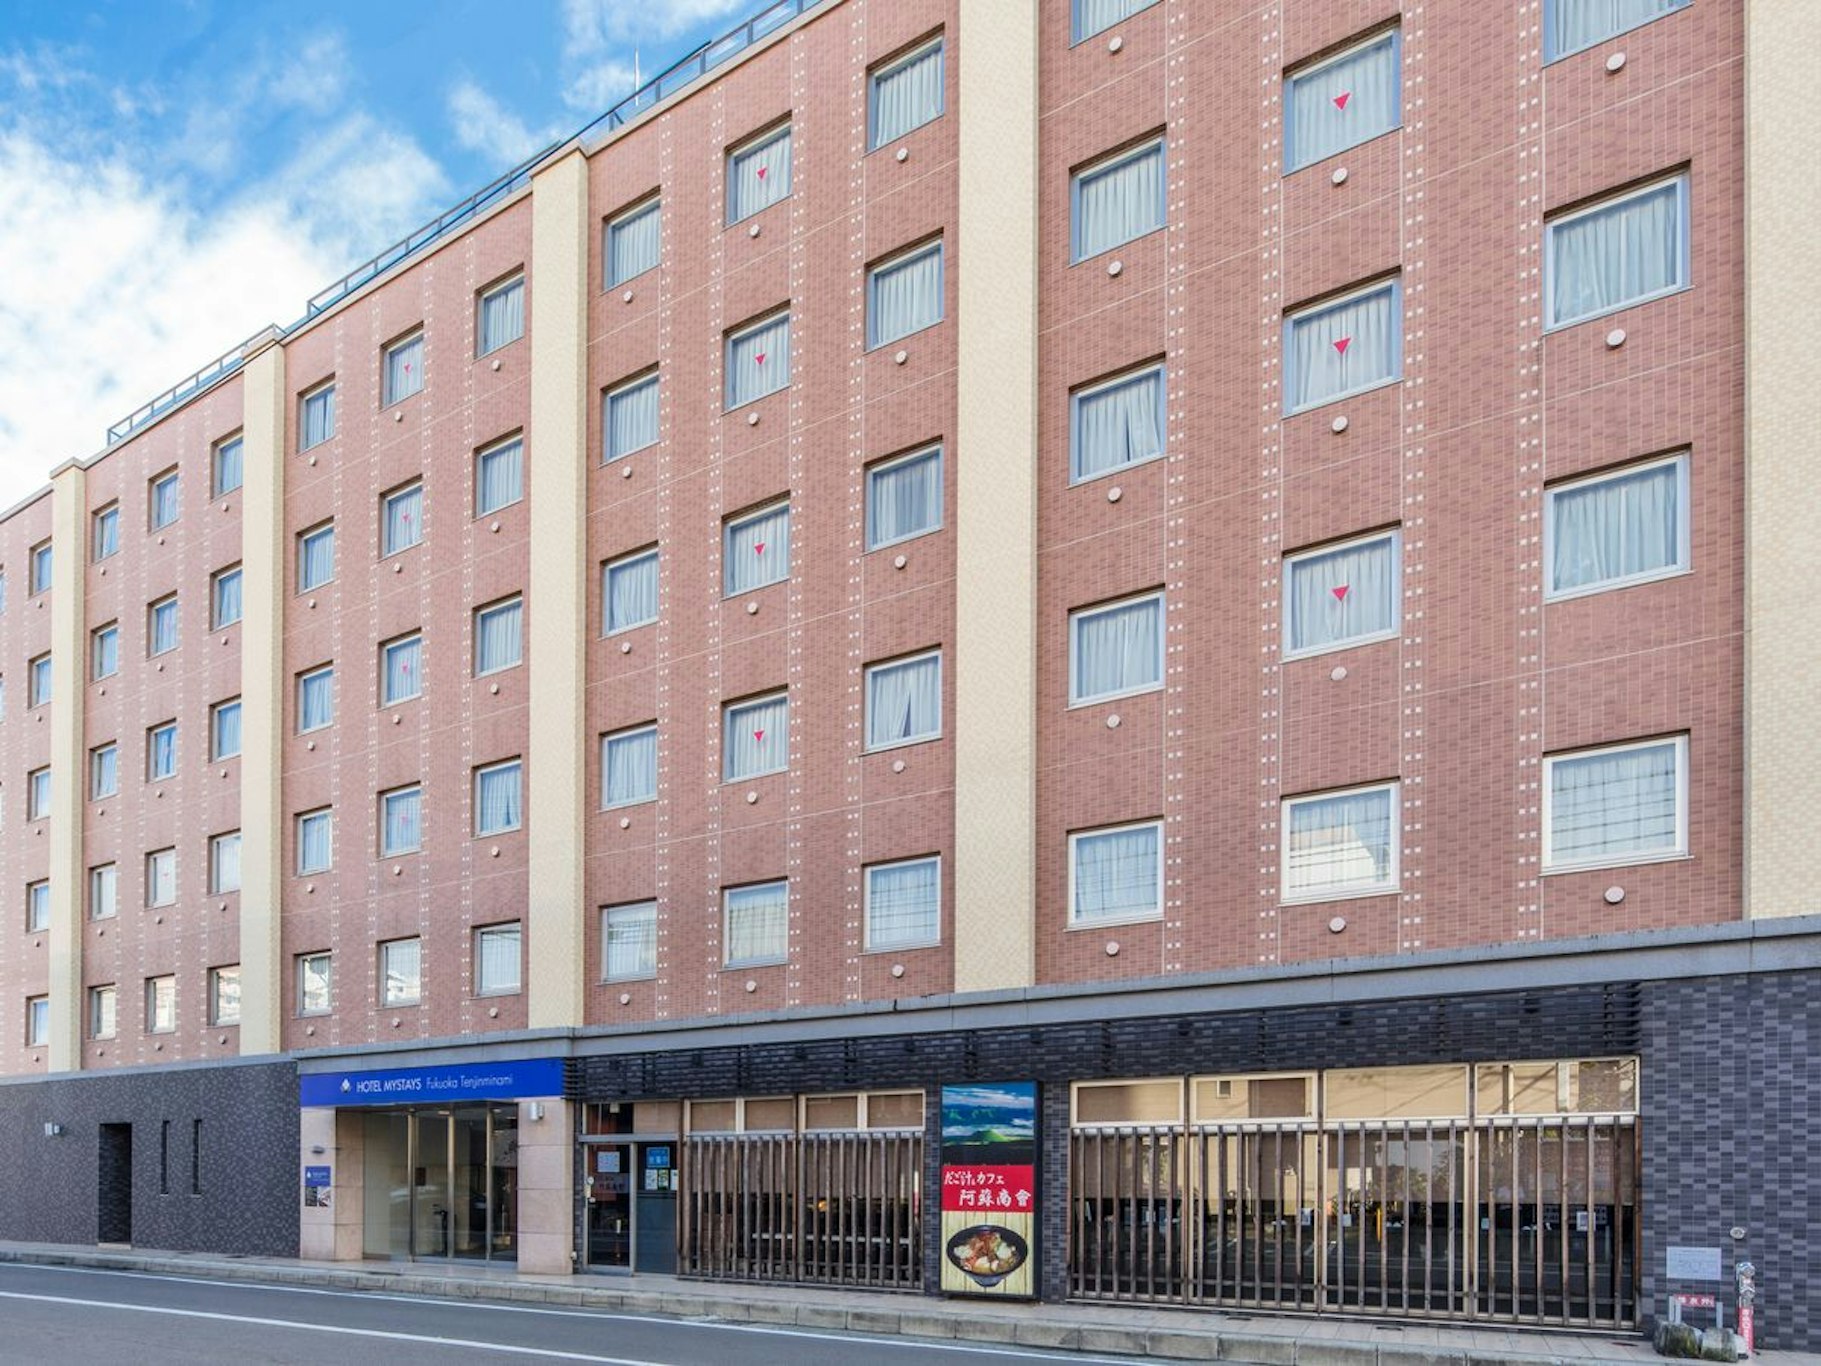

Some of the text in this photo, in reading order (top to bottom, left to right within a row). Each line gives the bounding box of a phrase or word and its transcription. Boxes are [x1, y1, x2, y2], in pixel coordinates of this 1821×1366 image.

[356, 1074, 513, 1093] HOTEL MYSTAYS Fukuoka Tenjinminami
